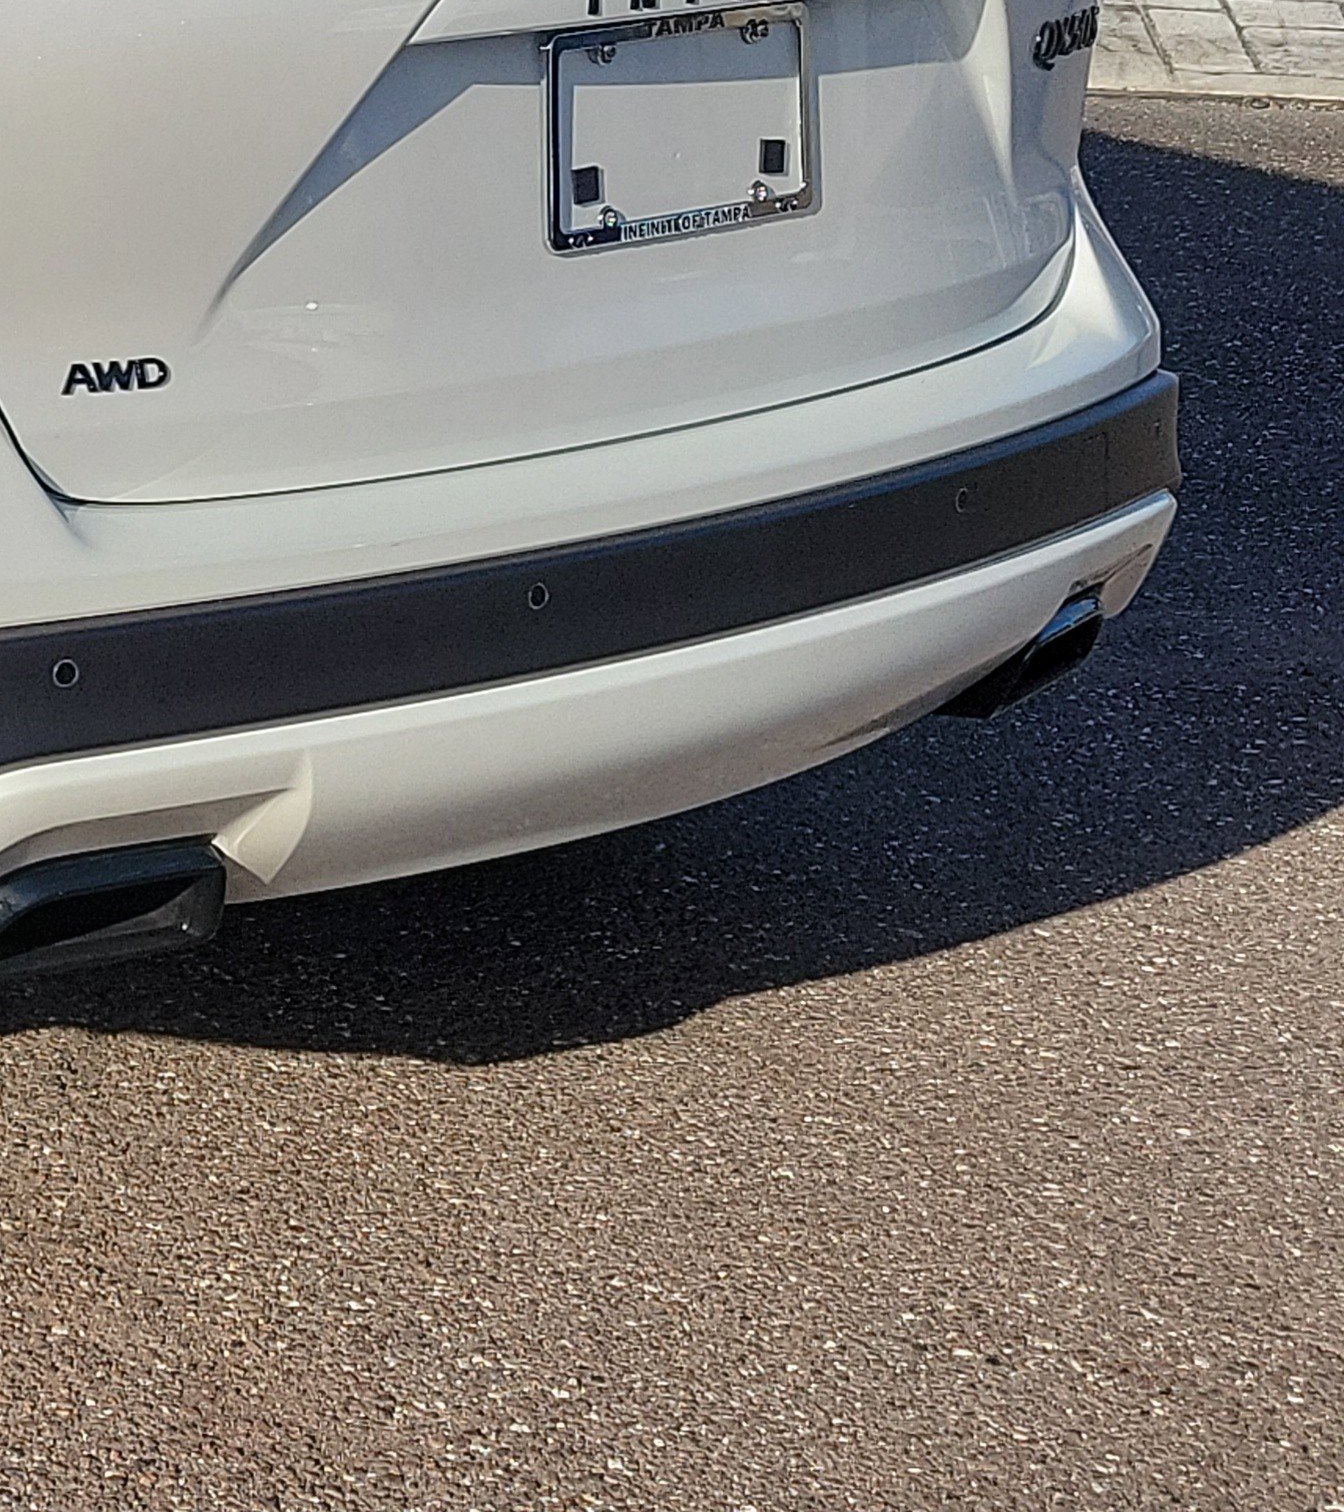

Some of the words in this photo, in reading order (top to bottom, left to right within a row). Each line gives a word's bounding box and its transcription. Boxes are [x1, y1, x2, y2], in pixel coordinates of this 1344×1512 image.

[643, 11, 726, 38] TAMPA
[681, 210, 703, 231] OF
[703, 205, 751, 227] TAMPA
[60, 356, 172, 396] AWD
